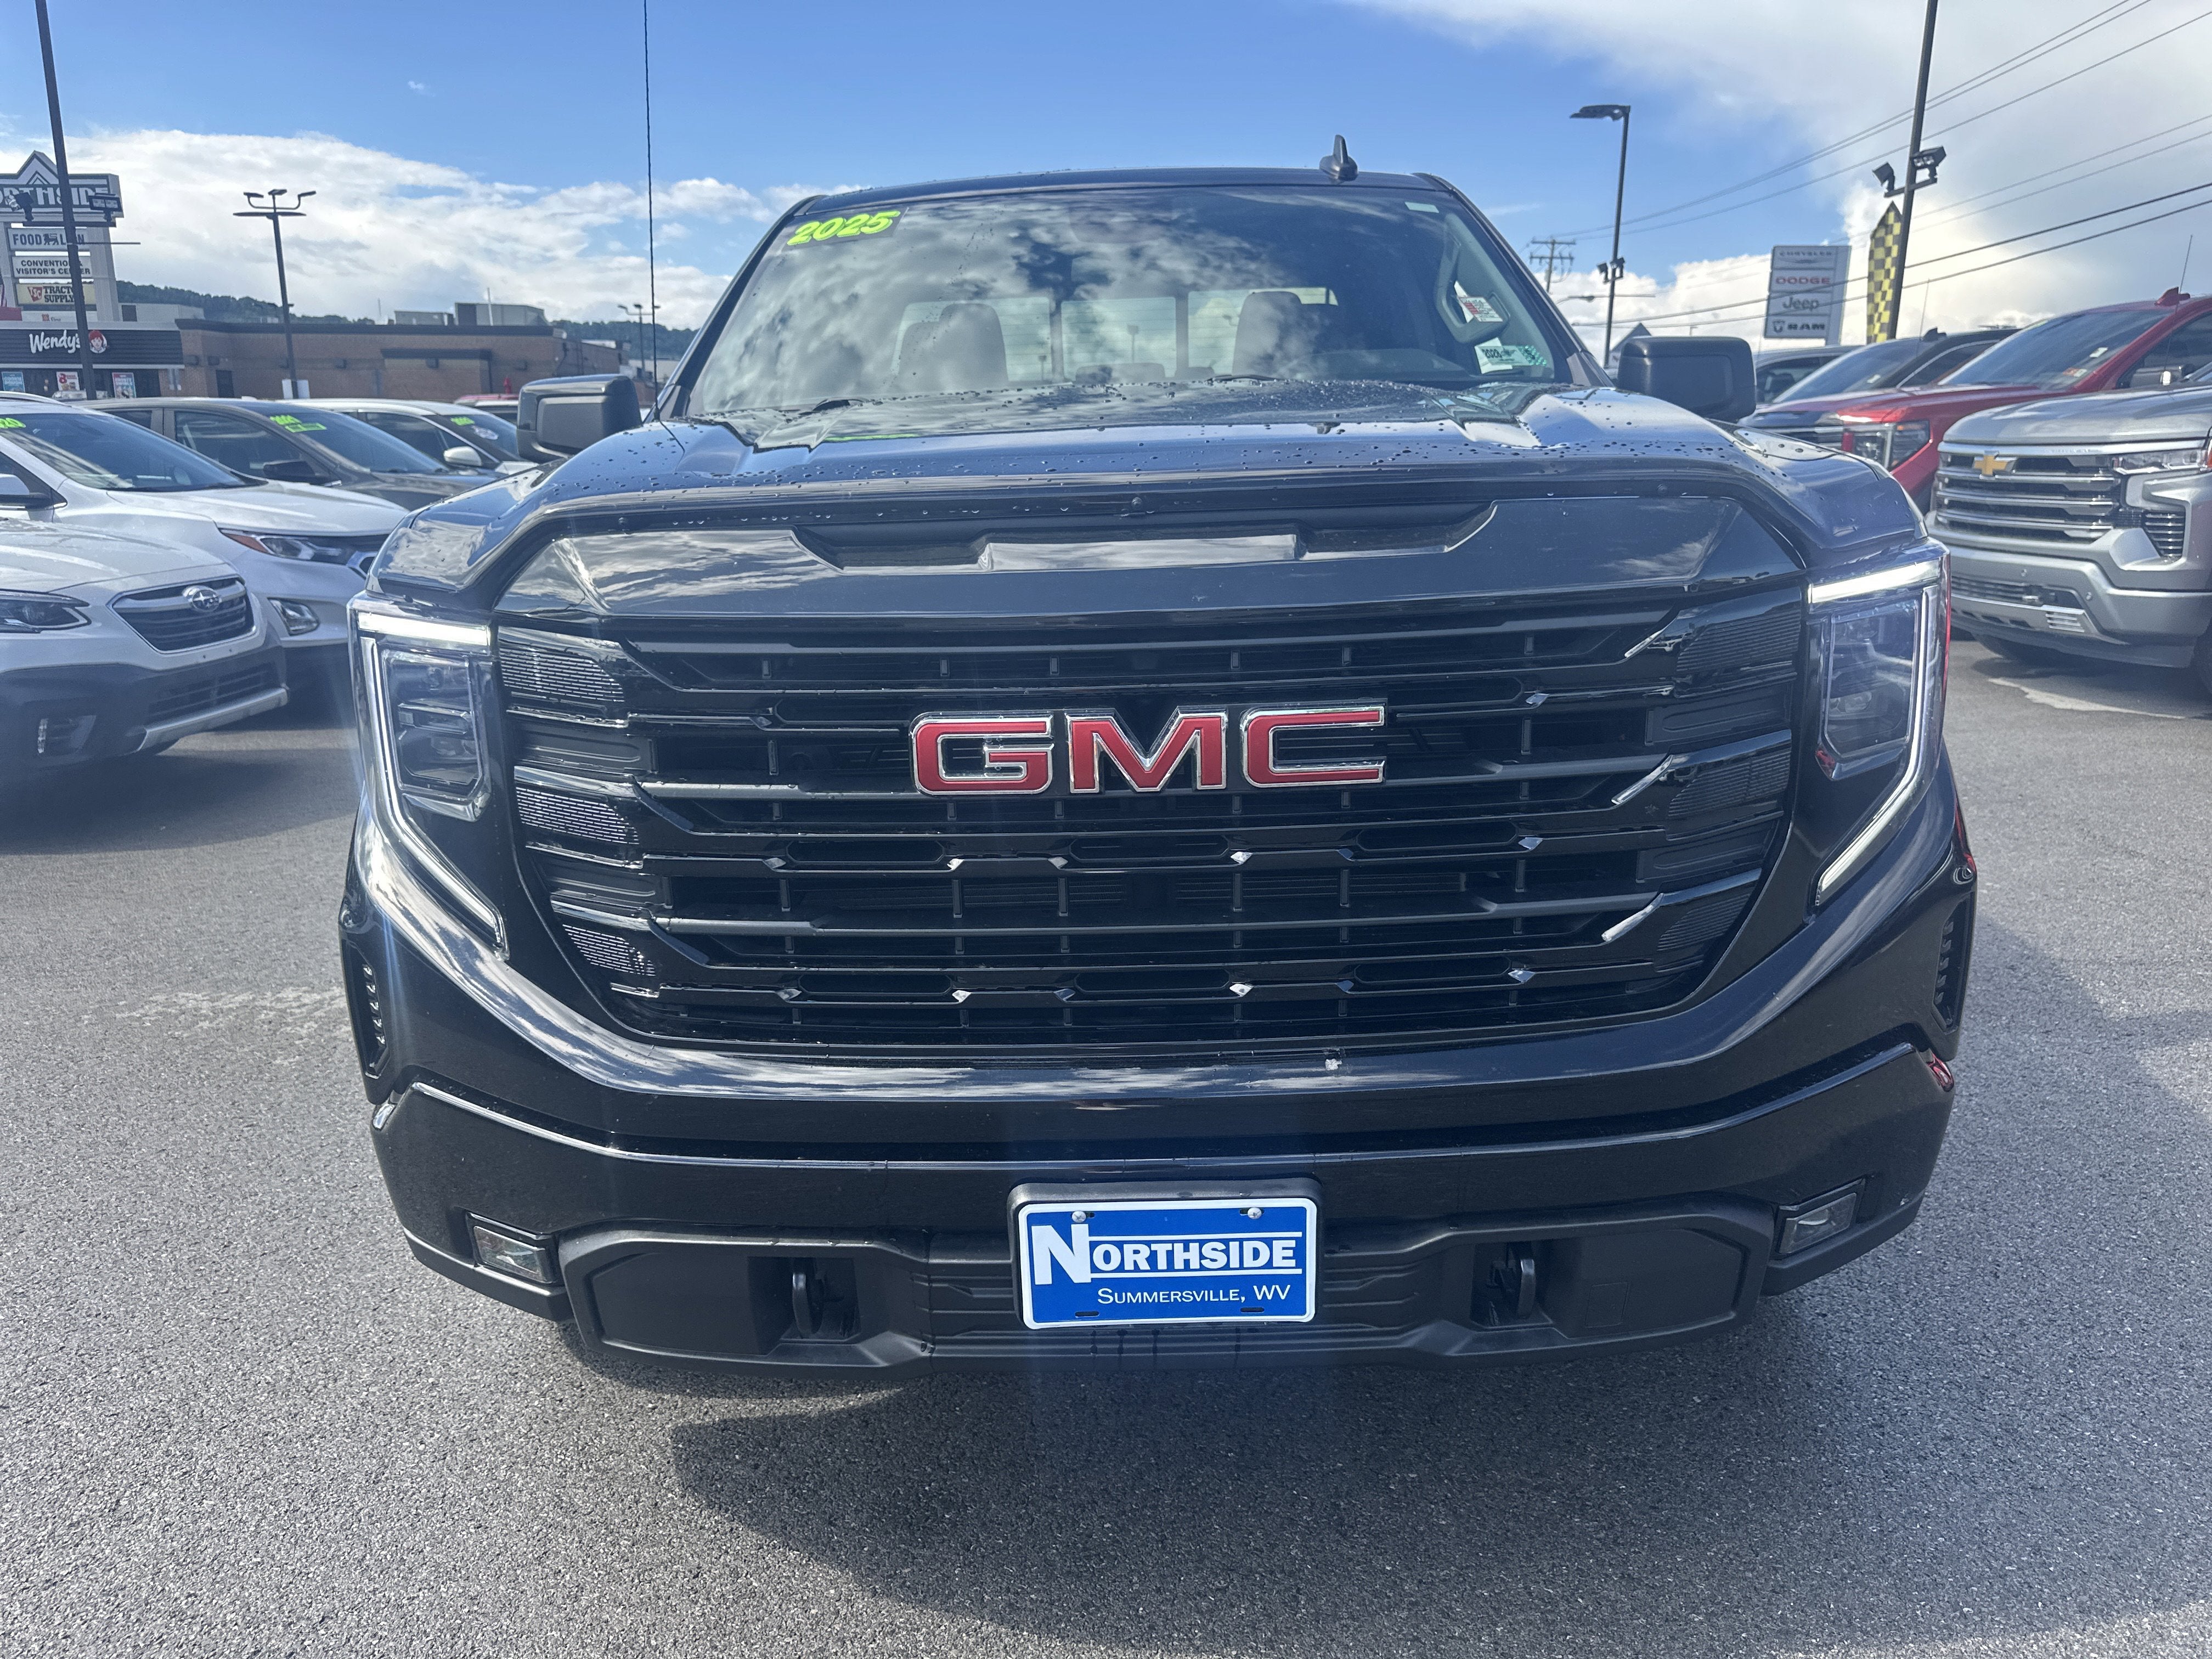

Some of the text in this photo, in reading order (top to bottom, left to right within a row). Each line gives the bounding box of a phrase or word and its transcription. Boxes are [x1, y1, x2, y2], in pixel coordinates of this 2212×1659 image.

[13, 234, 84, 245] FOOD LN
[787, 210, 901, 246] 2025
[1782, 297, 1819, 311] Jeep
[29, 330, 81, 354] Wendy's
[910, 700, 1387, 795] GMC
[1031, 1223, 1296, 1285] NORTHSIDE
[1098, 1284, 1291, 1304] SUMMERSVILLE, WV
